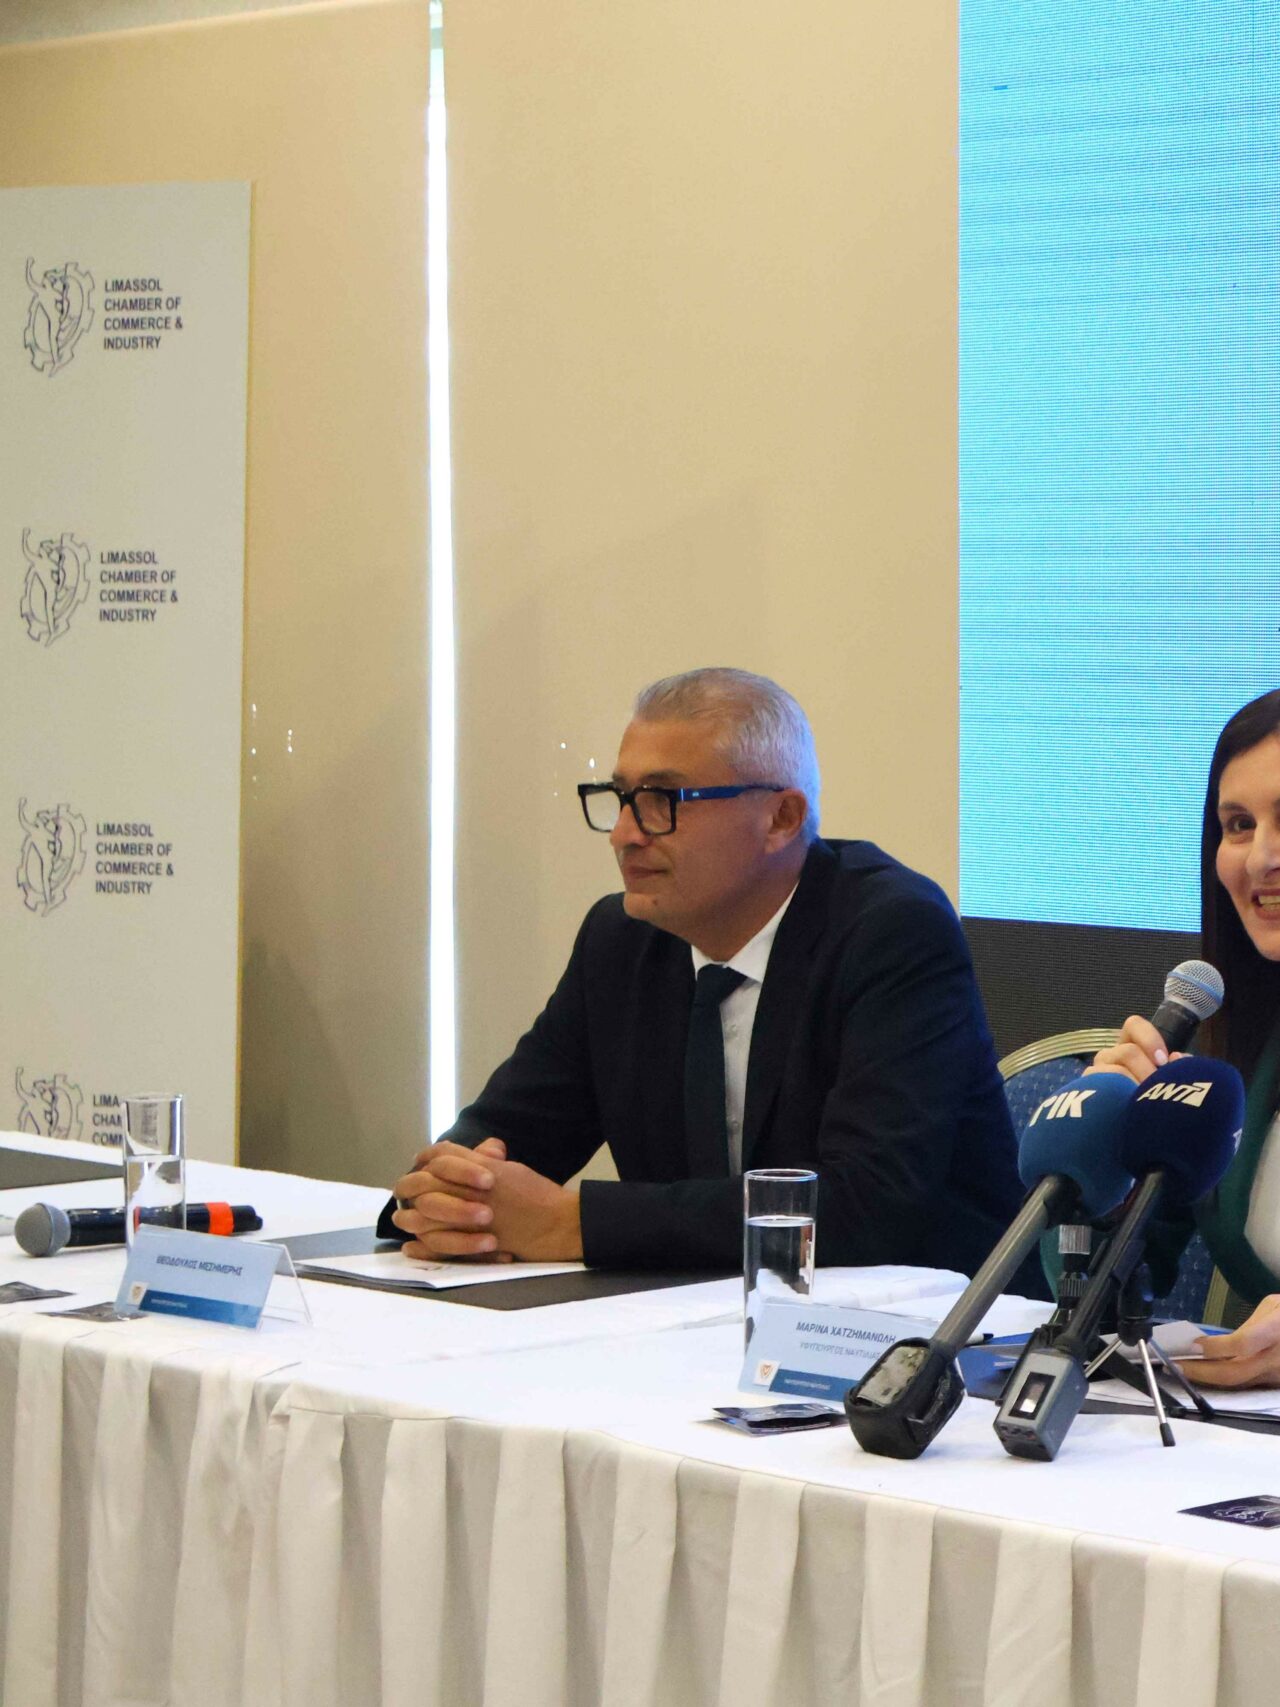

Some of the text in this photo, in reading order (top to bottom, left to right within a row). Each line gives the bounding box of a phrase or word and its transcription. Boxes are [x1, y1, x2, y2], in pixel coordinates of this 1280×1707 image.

[104, 279, 163, 292] LIMASSOL
[104, 297, 182, 311] CHAMBER OF
[104, 316, 183, 330] COMMERCE &
[103, 336, 161, 350] INDUSTRY
[100, 551, 159, 564] LIMASSOL
[100, 570, 176, 583] CHAMBER OF
[100, 589, 179, 603] COMMERCE &
[99, 608, 157, 622] INDUSTRY
[96, 823, 154, 837] LIMASSOL
[96, 842, 173, 856] CHAMBER OF
[95, 861, 175, 876] COMMERCE &
[95, 880, 153, 894] INDUSTRY
[93, 1094, 120, 1107] LIMA
[796, 1321, 896, 1344] ΜΑΡΙΝΑ ΧΑΤΖΗΜΑΝΩΛΗ
